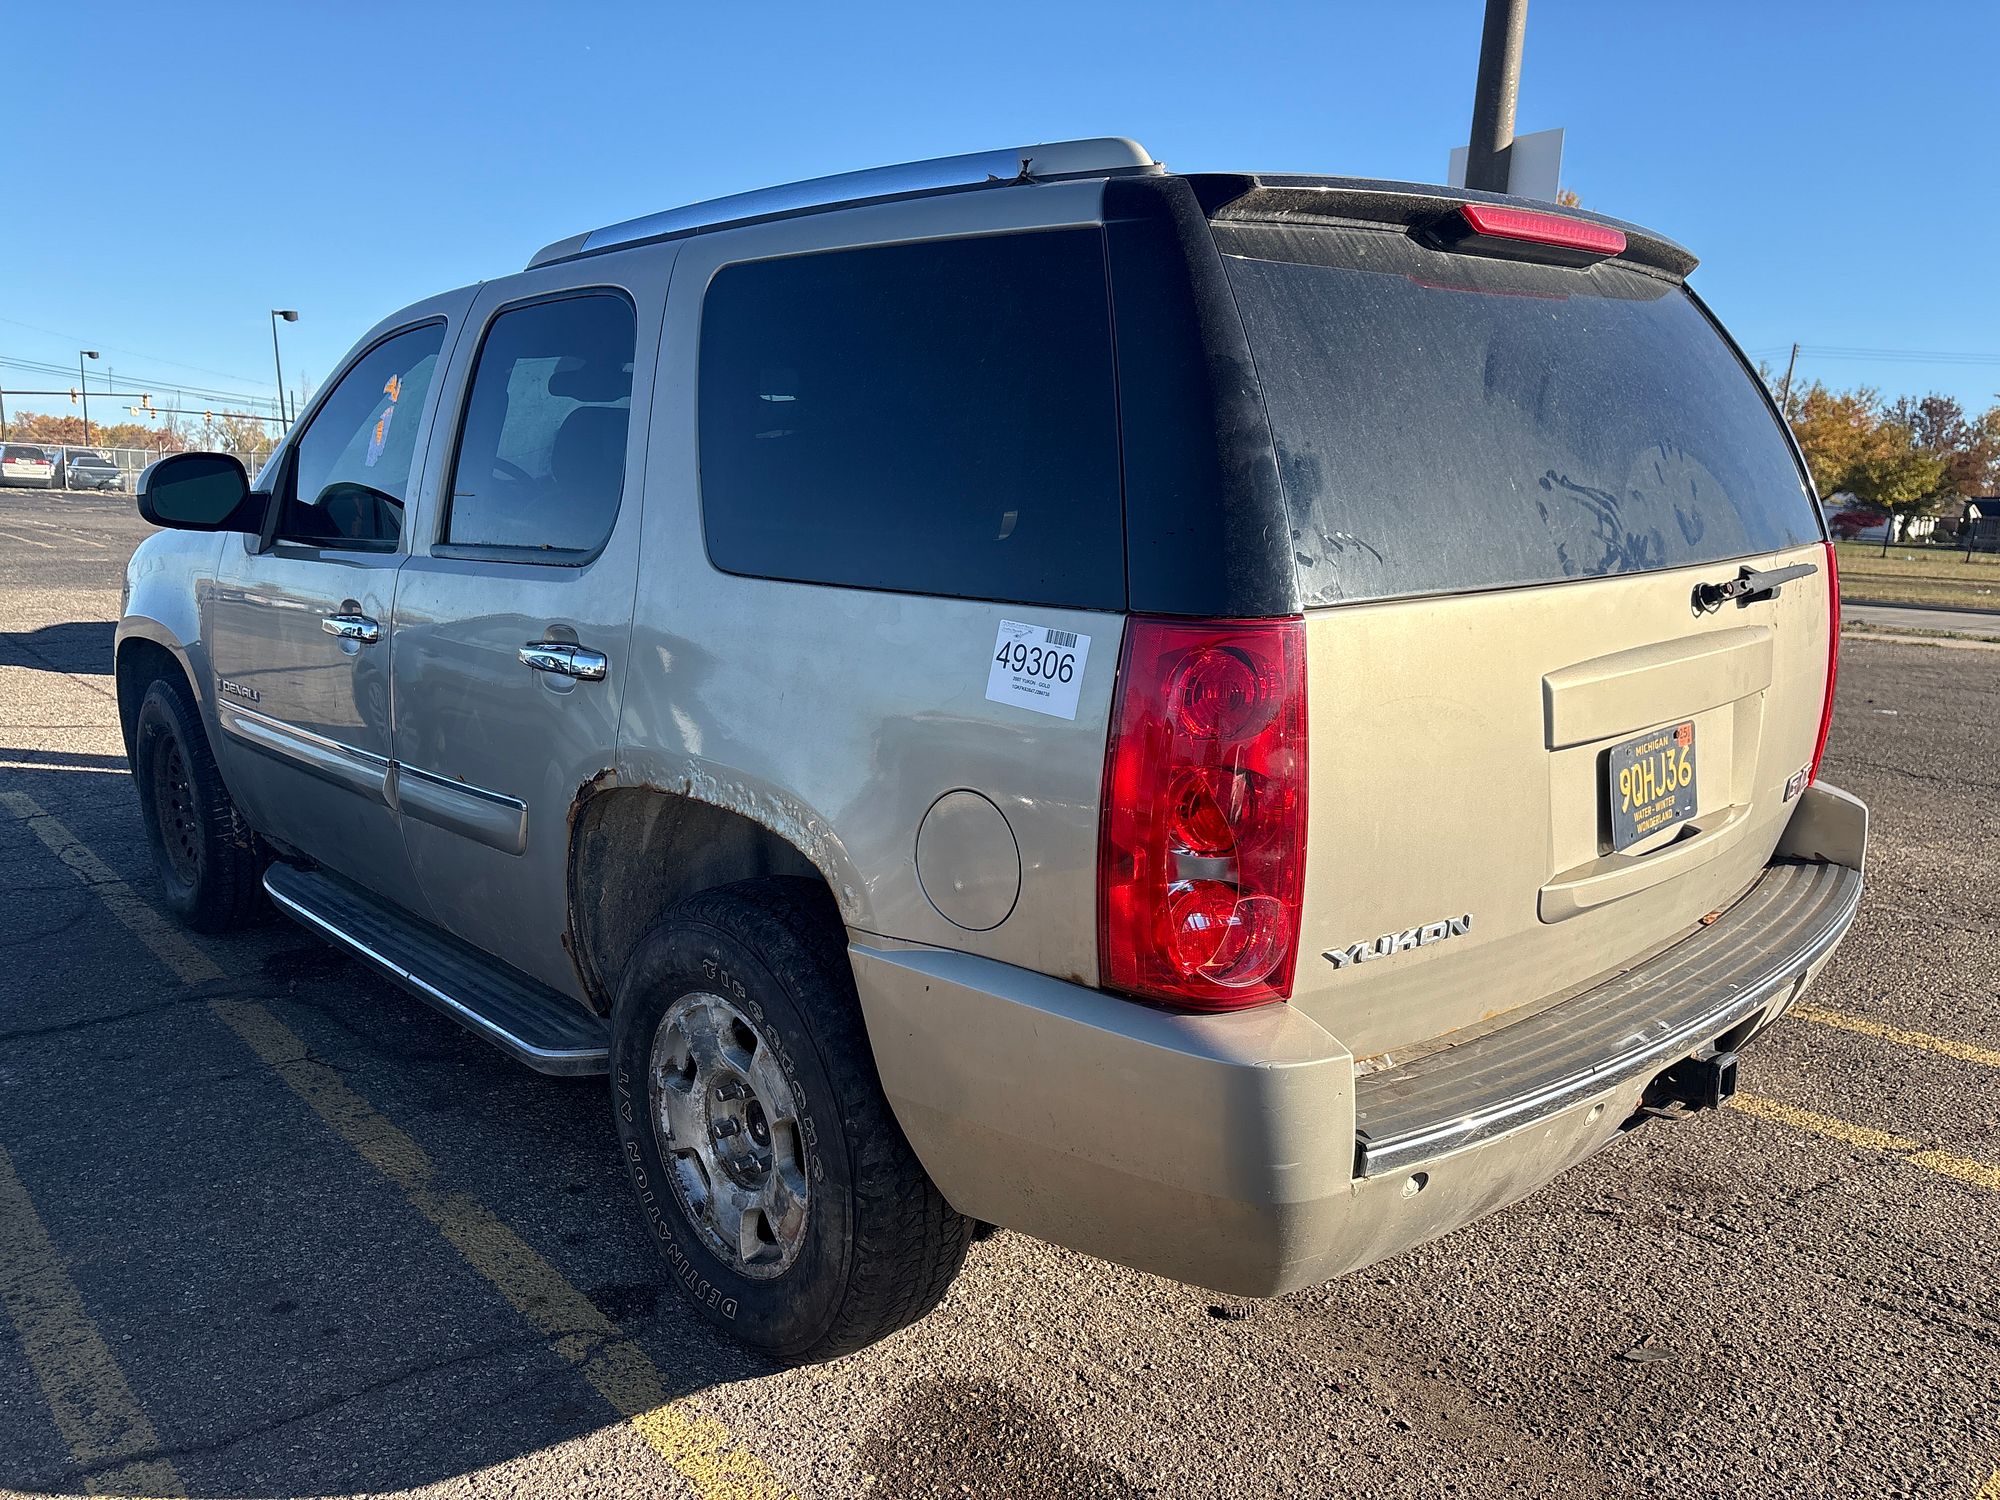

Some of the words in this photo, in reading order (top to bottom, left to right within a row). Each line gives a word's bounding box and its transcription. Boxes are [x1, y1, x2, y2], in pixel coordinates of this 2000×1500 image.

[996, 641, 1075, 683] 49306
[222, 680, 260, 703] DENALI
[1635, 735, 1669, 757] MICHIGAN
[1619, 745, 1692, 813] 9QHJ36
[1636, 809, 1673, 834] WONDERLAND
[1321, 912, 1474, 970] YUKON
[617, 1067, 633, 1123] A/T
[626, 1140, 738, 1320] DESTINATION
